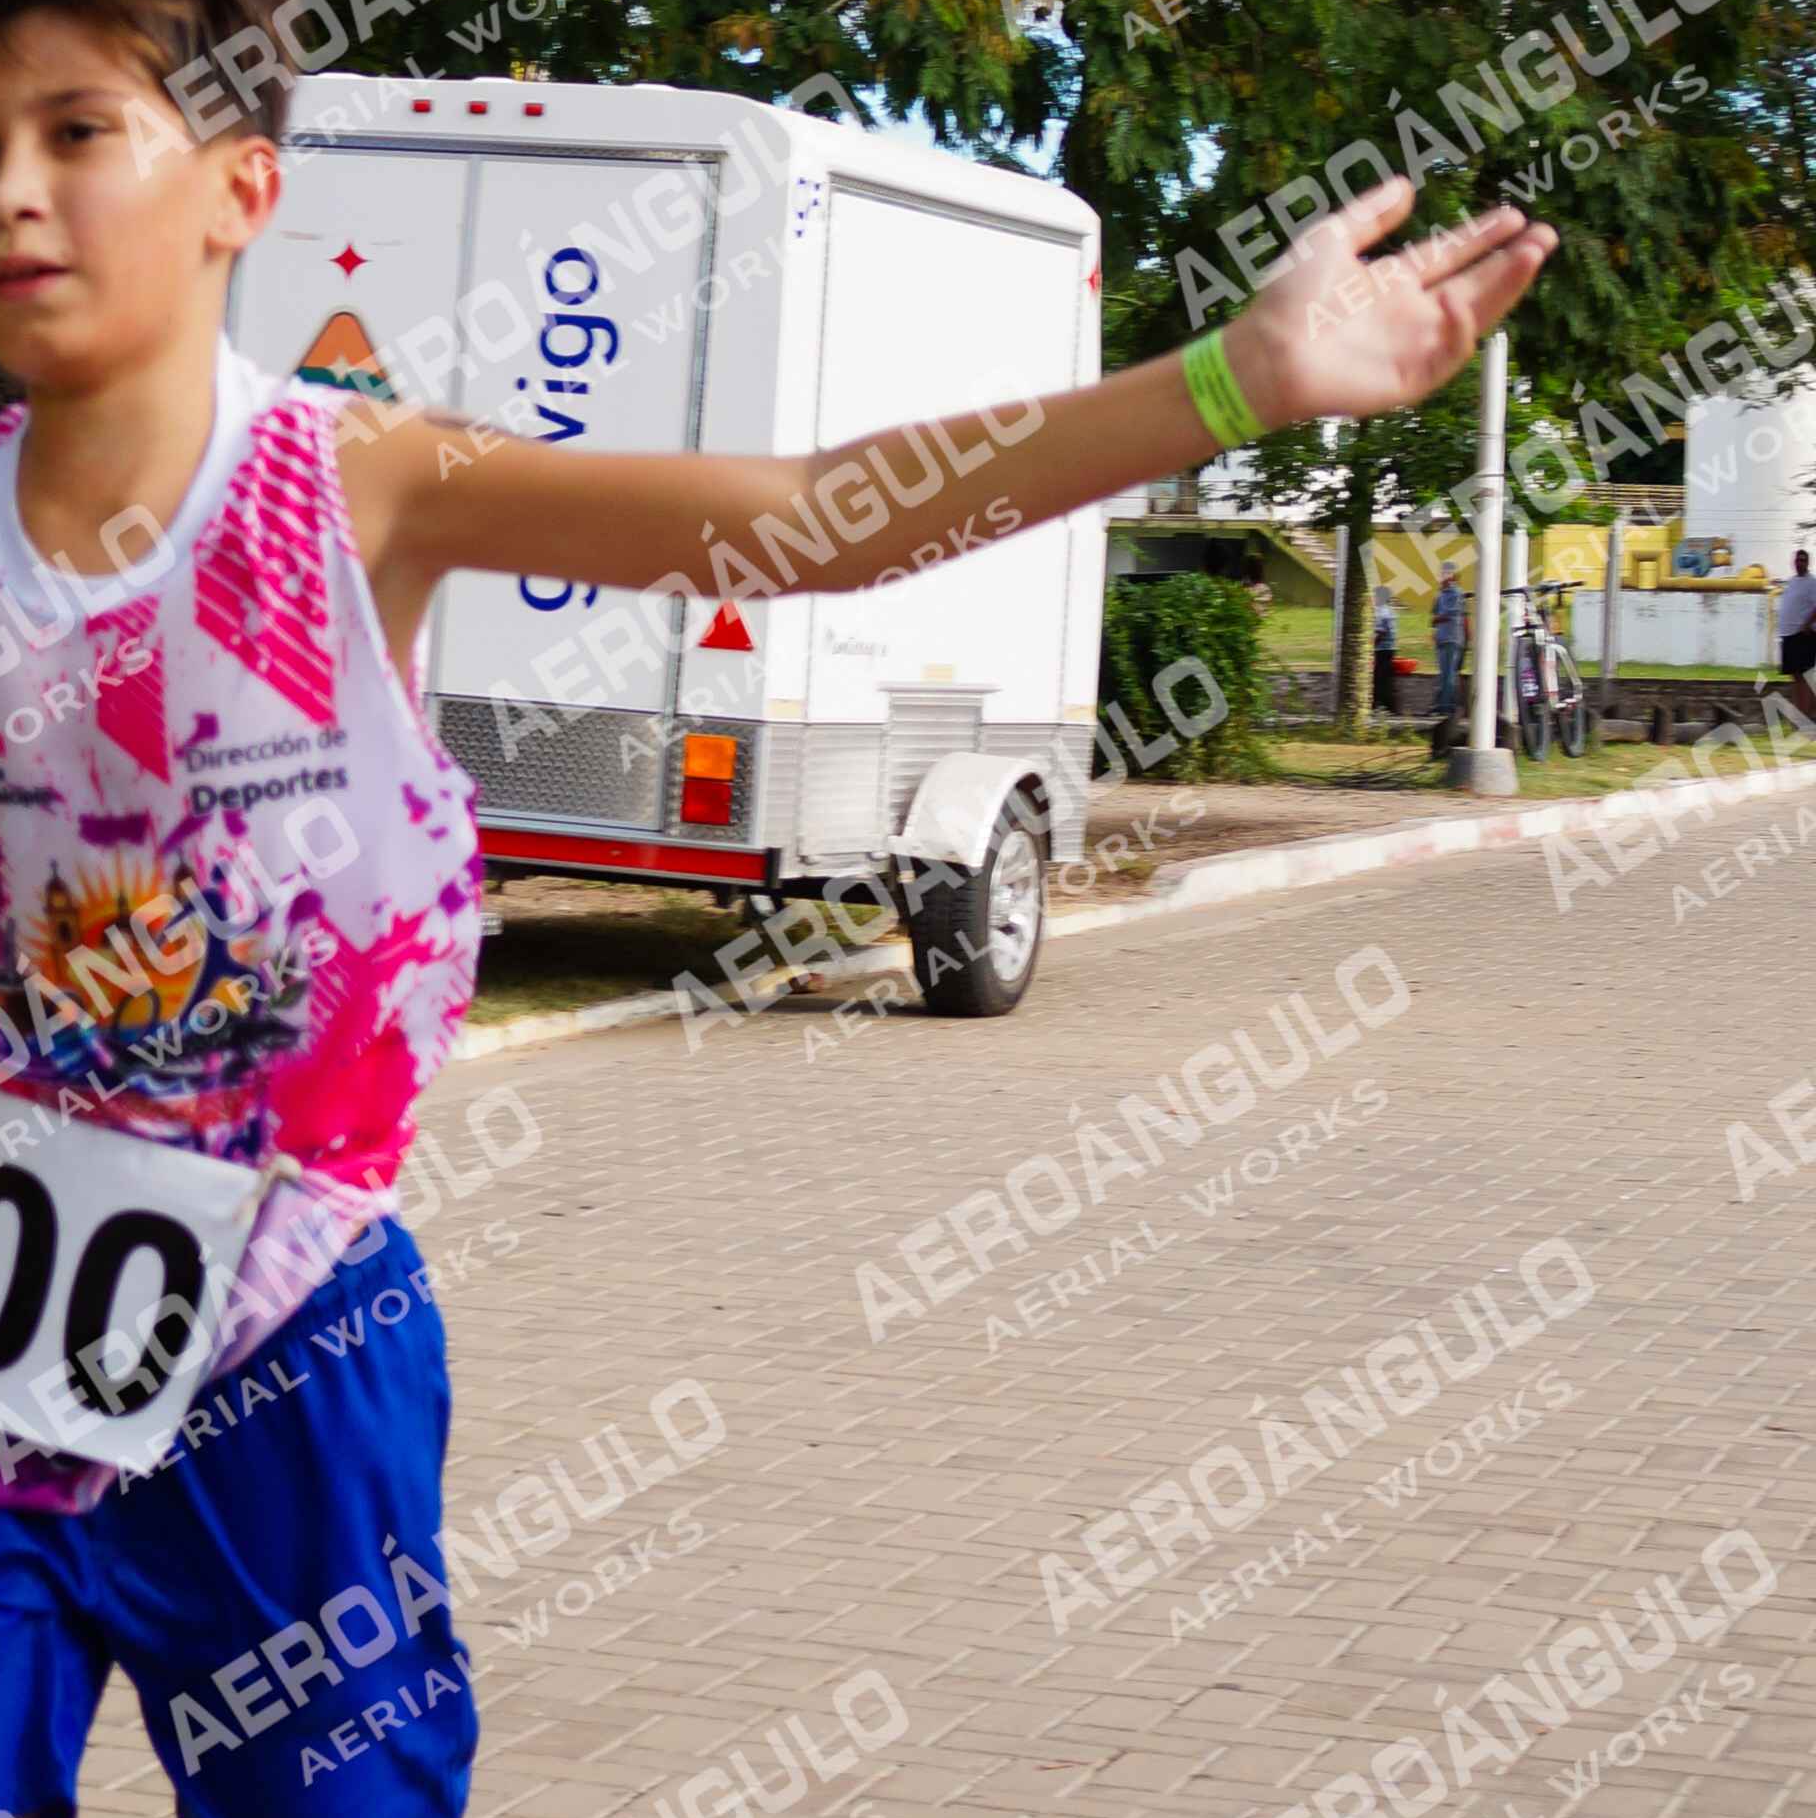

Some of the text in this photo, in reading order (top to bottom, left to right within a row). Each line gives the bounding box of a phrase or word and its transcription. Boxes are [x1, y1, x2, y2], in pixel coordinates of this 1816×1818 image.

[186, 728, 348, 773] Dirección de
[190, 766, 349, 815] Deportes
